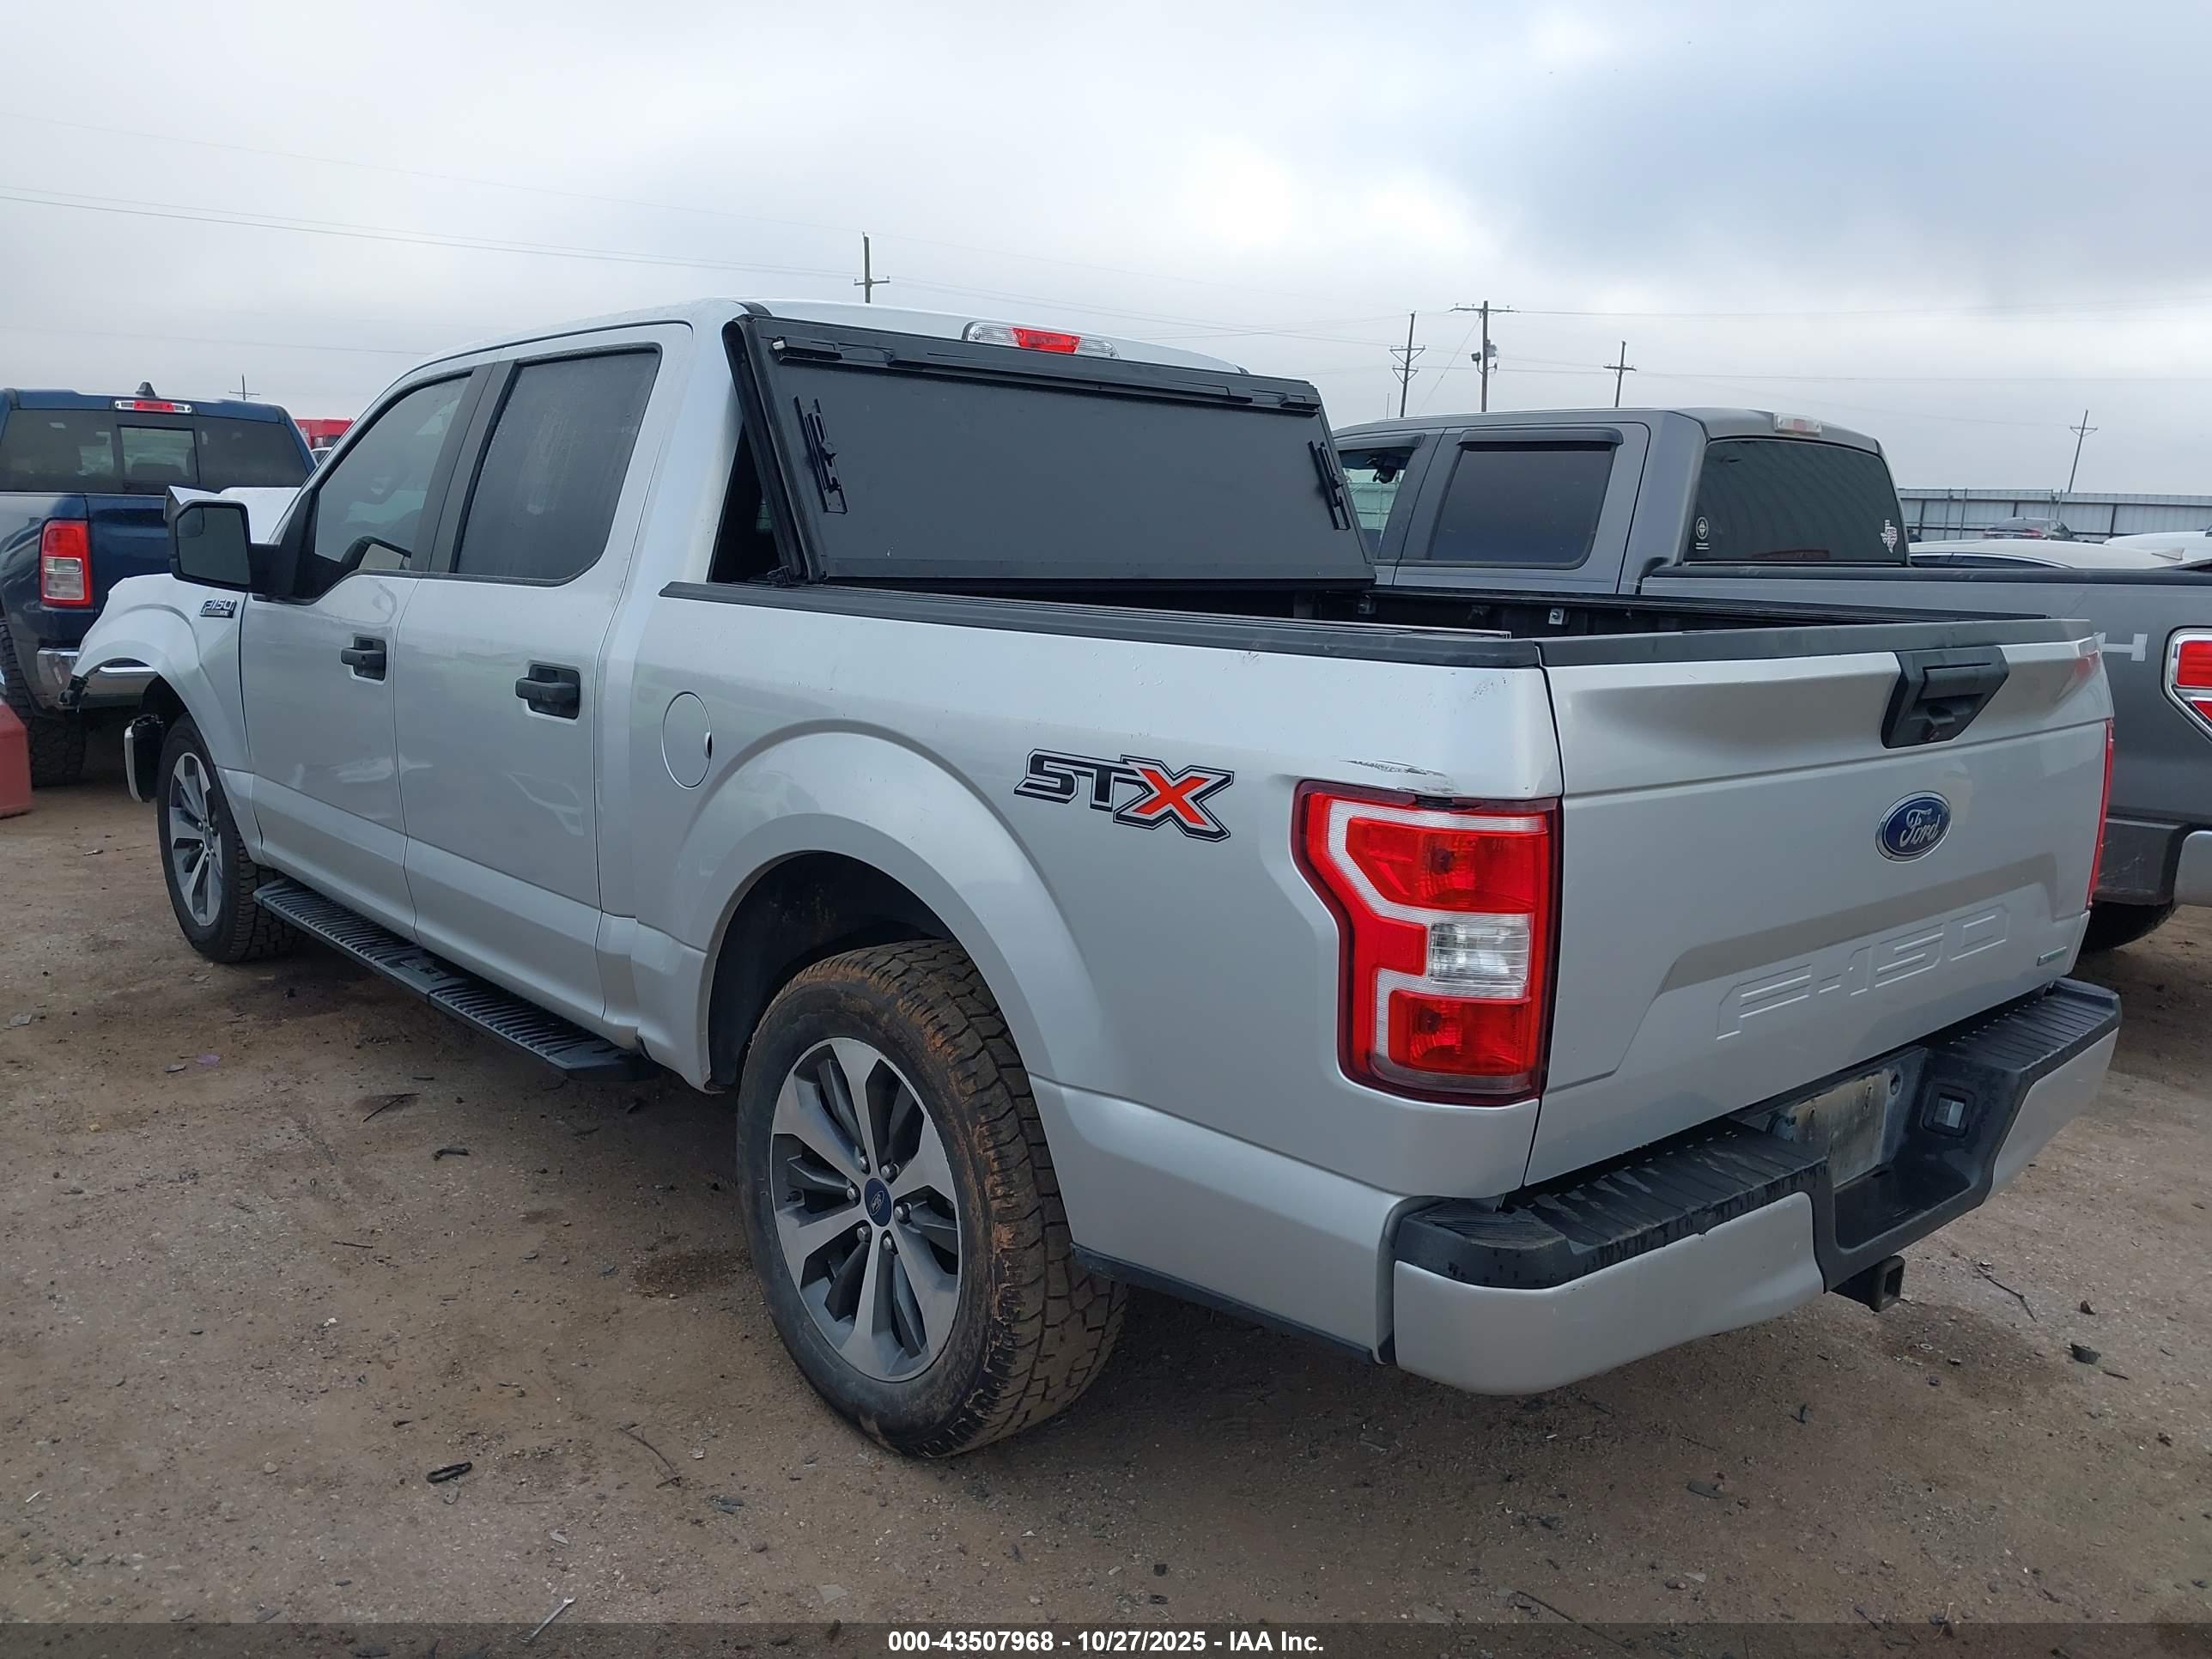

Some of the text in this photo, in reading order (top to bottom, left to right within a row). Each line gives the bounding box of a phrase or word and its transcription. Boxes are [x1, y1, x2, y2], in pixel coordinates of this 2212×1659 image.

[1015, 750, 1235, 842] STX
[1899, 808, 1941, 848] Ford
[1717, 903, 2008, 1040] F-150
